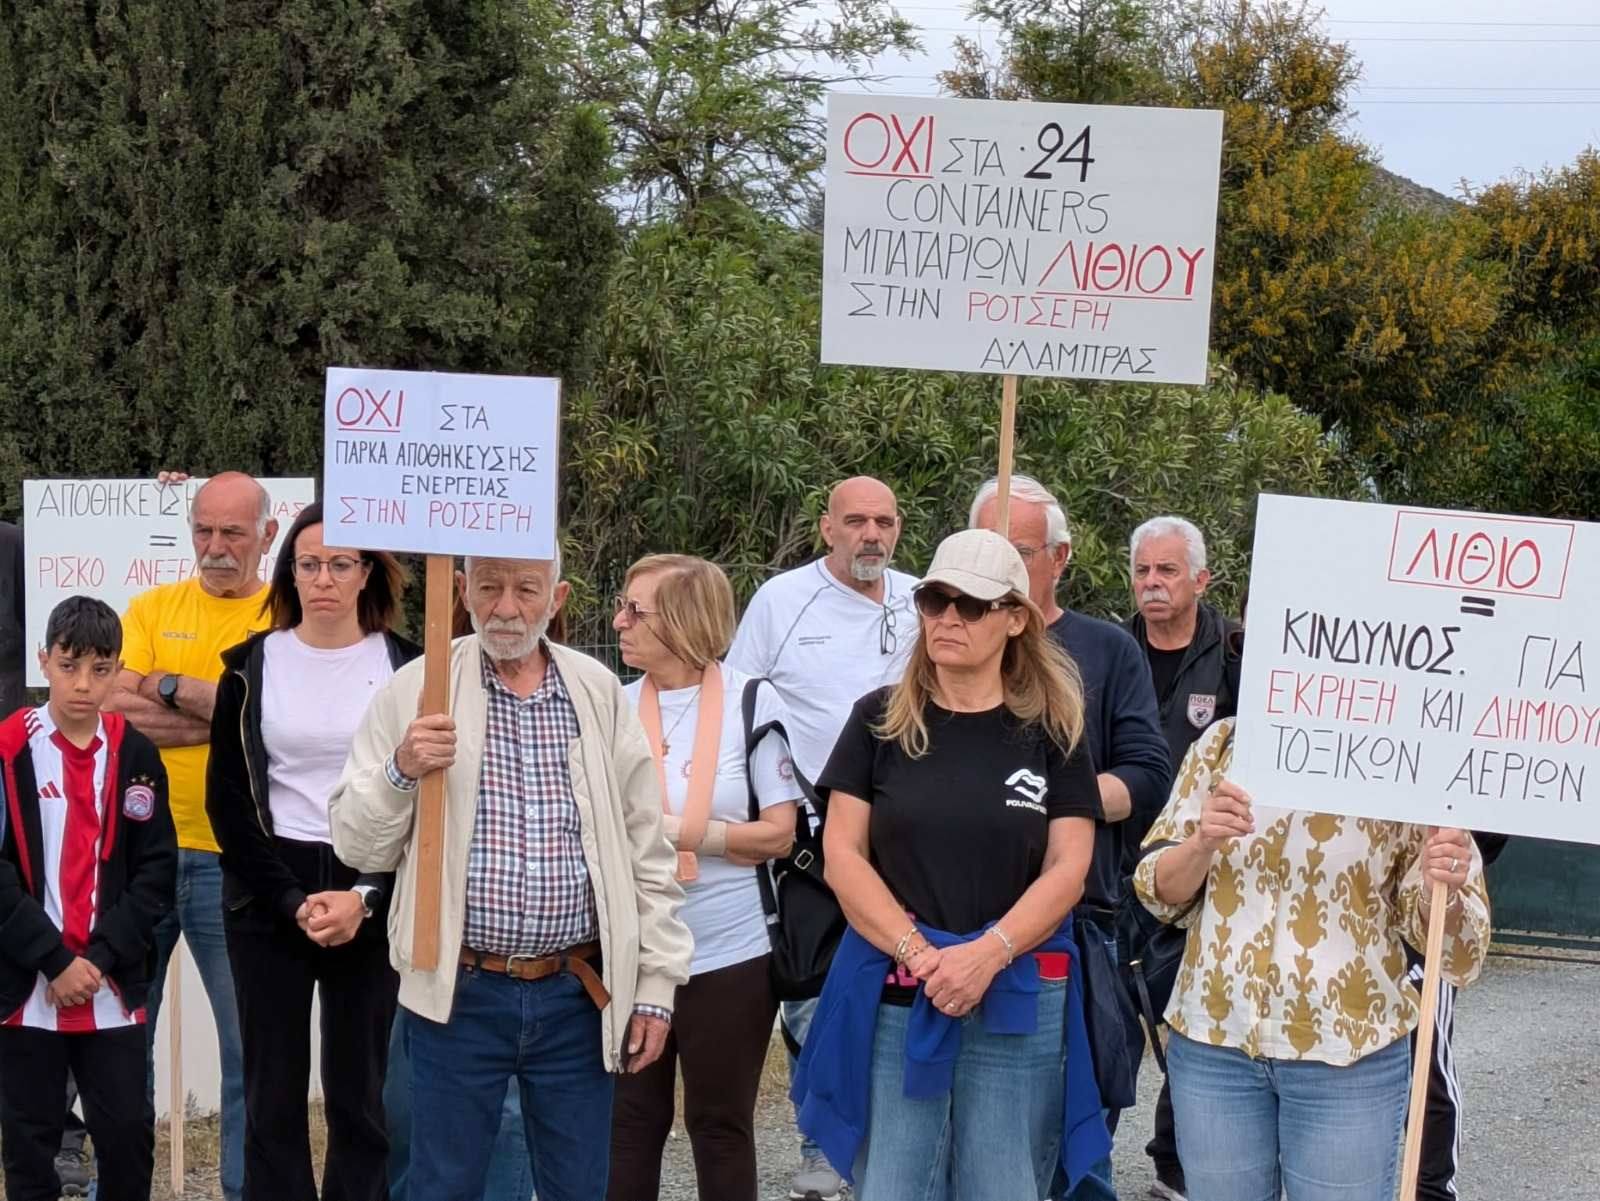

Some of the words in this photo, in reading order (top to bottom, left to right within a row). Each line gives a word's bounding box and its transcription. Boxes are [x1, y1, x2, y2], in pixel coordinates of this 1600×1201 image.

[843, 112, 935, 173] ΟΧΙ
[941, 138, 1006, 176] ΣΤΑ
[1023, 122, 1095, 182] 24
[886, 179, 1111, 234] CONTAINERS
[843, 227, 1030, 286] ΜΠΑΤΑΡΙΩΝ
[1039, 240, 1205, 295] ΛΙΘΙΟΥ
[848, 282, 941, 319] ΣΤΗΝ
[968, 292, 1112, 331] ΡΟΤΣΕΡΗ
[336, 387, 404, 427] ΟΧΙ
[440, 404, 490, 431] ΣΤΑ
[336, 440, 388, 465] ΠΑΡΚΑ
[395, 442, 539, 472] ΑΠΟΘΗΚΕΥΣΗΣ
[340, 497, 406, 525] ΣΤΗΝ
[429, 500, 532, 532] ΡΟΤΣΕΡΗ
[402, 475, 510, 499] ΕΝΕΡΓΕΙΑΣ
[1405, 528, 1542, 590] ΛΙΘΙΟ
[1518, 635, 1585, 692] ΓΙΑ
[1267, 670, 1397, 724] ΕΚΡΗΞΗ
[1421, 687, 1464, 732] ΚΑΙ
[1271, 724, 1421, 784] ΤΟΞΙΚΩΝ
[1446, 748, 1585, 802] ΑΕΡΙΩΝ
